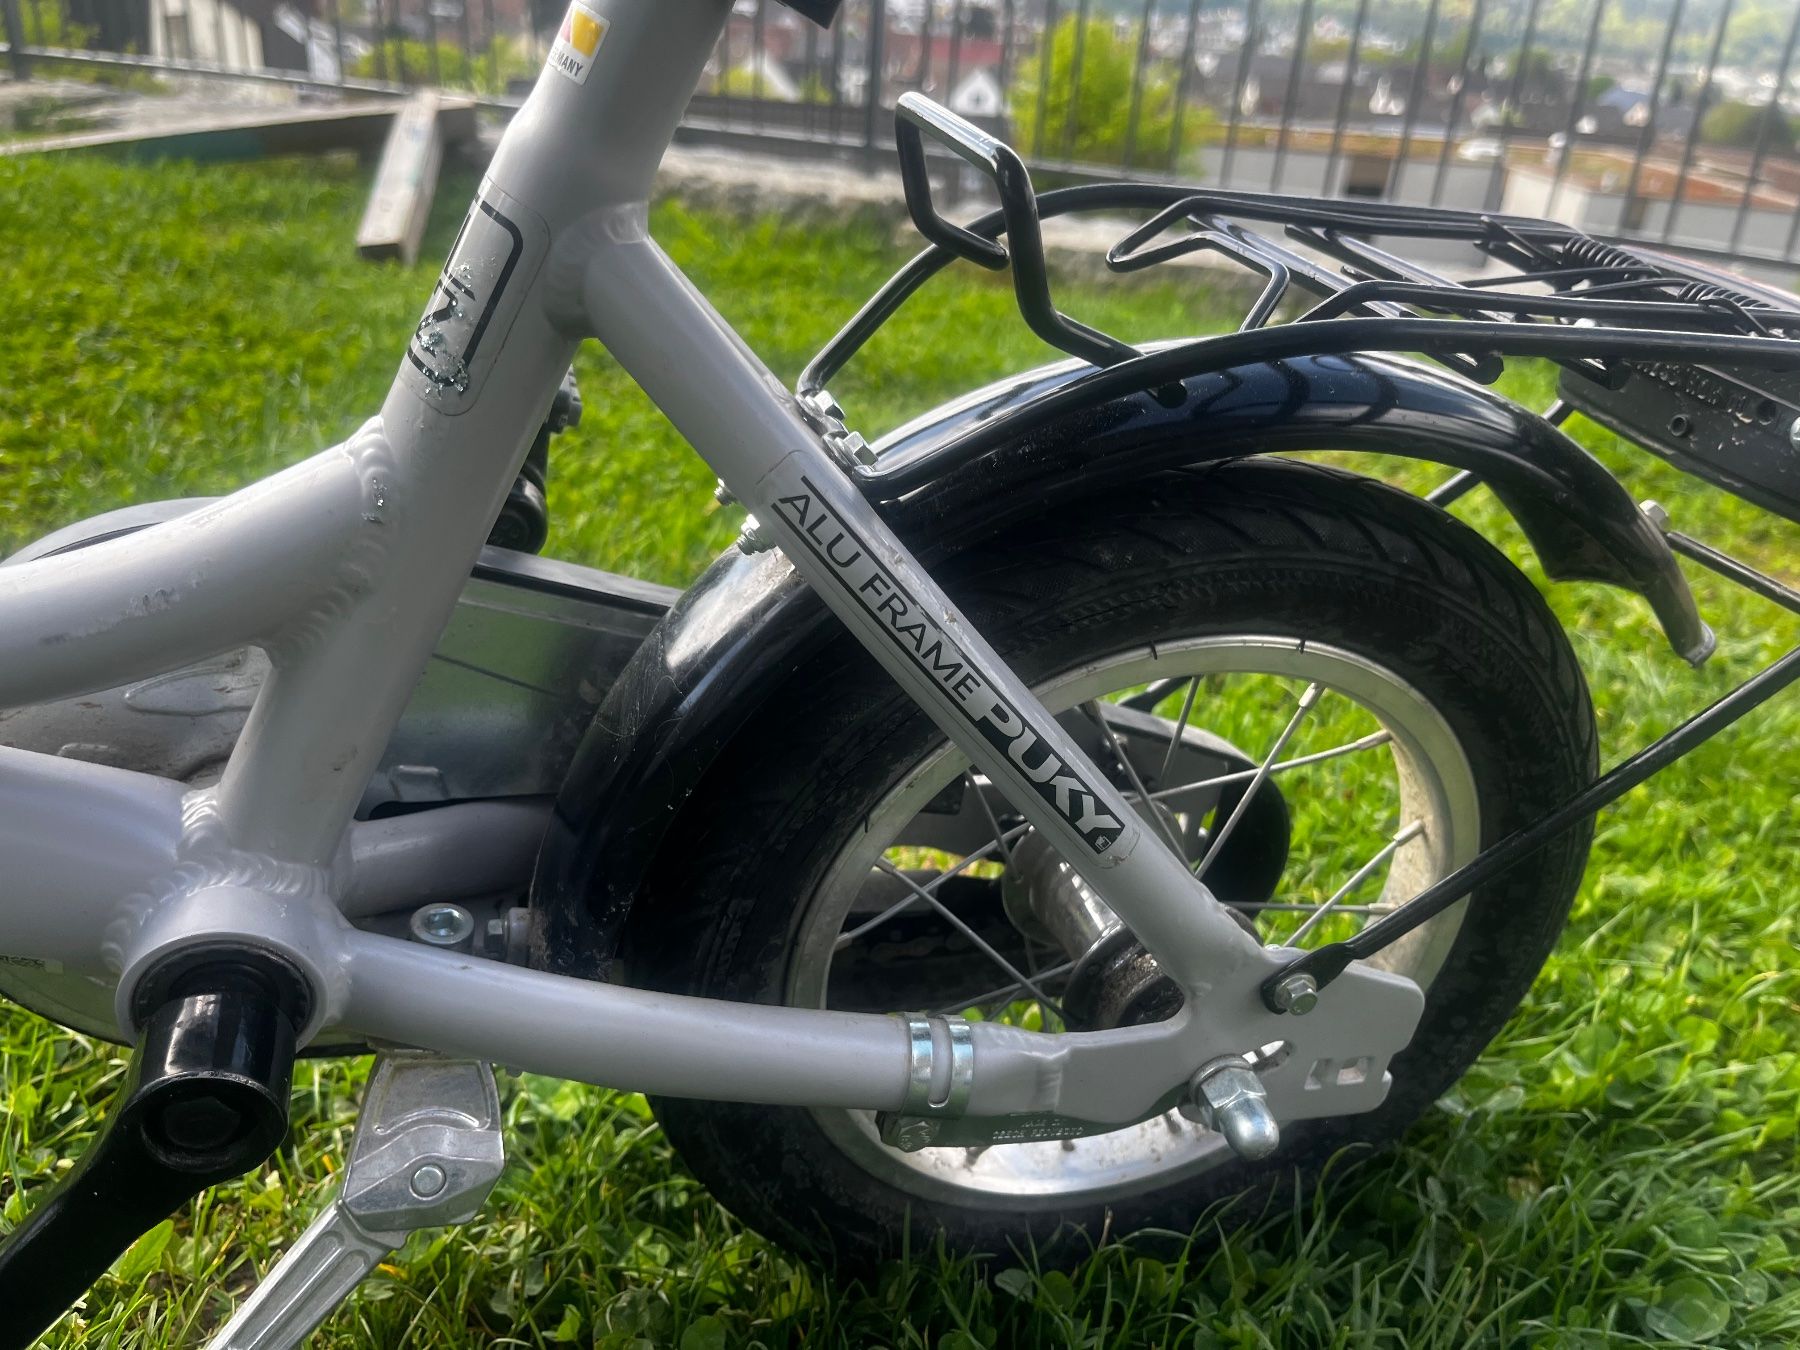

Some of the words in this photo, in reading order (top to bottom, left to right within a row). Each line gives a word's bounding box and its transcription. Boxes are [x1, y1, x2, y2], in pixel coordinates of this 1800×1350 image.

[778, 493, 860, 569] ALU
[859, 572, 981, 701] FRAME
[975, 703, 1122, 834] PUKY
